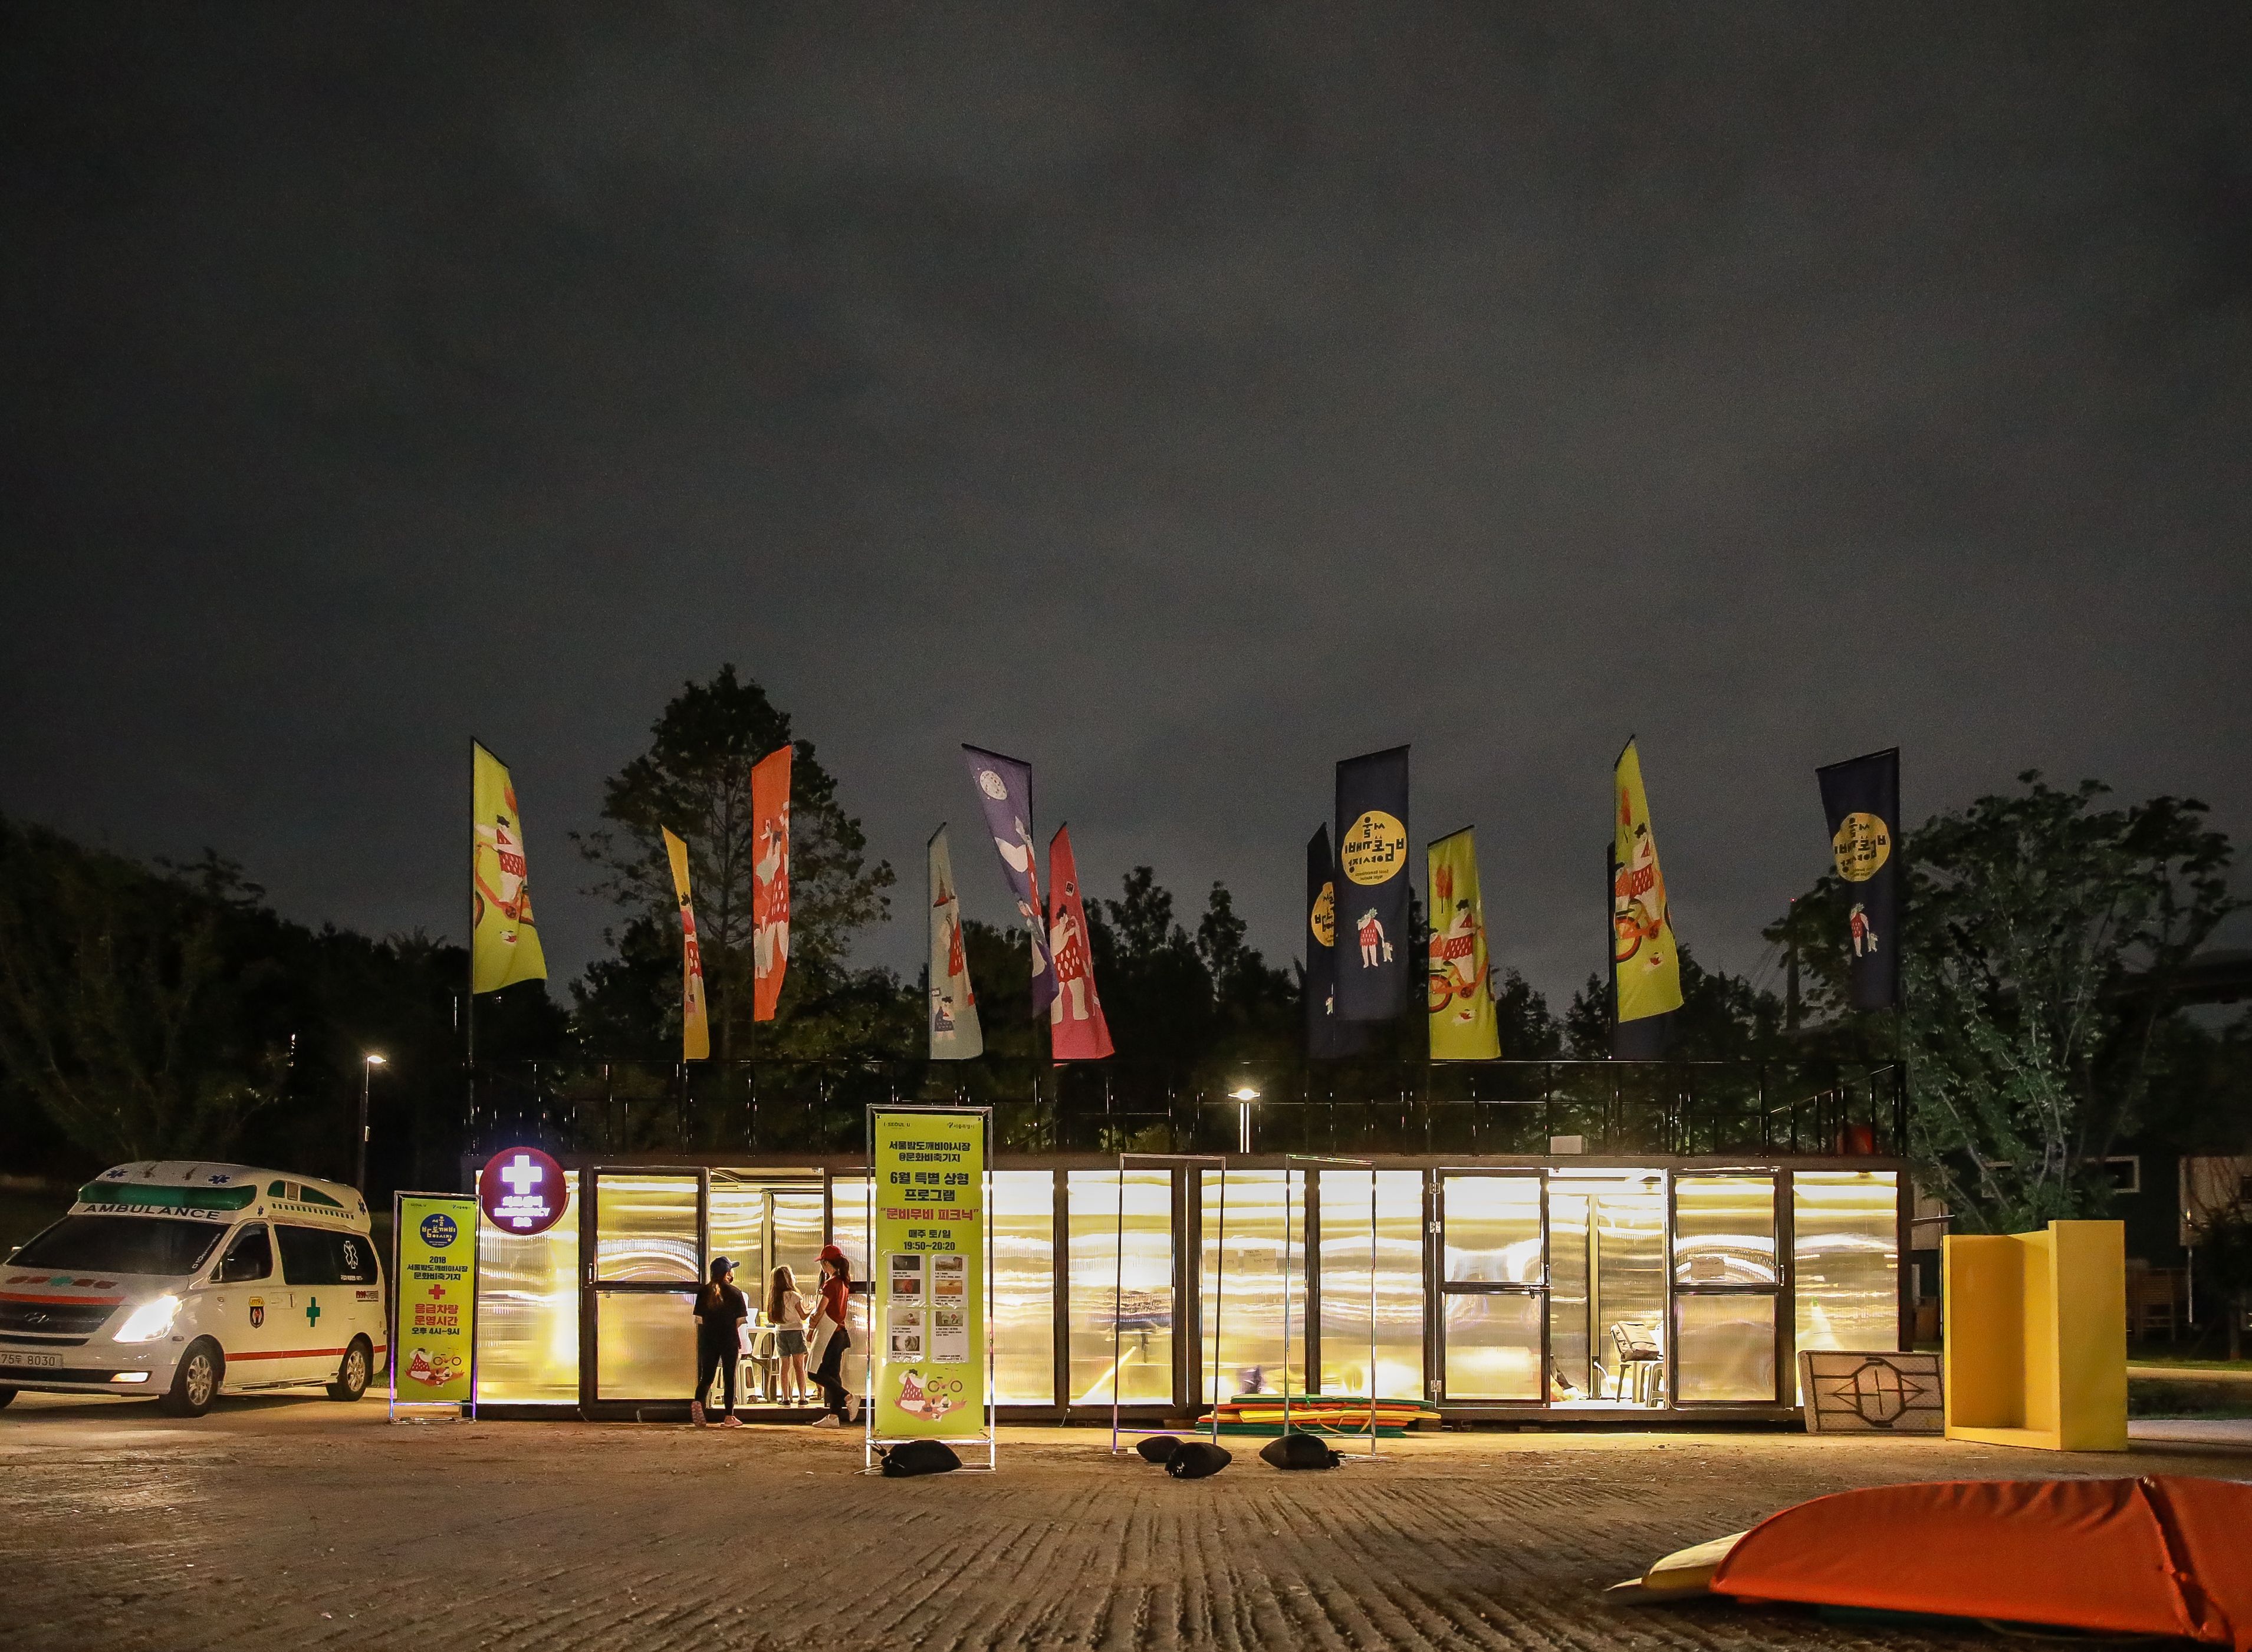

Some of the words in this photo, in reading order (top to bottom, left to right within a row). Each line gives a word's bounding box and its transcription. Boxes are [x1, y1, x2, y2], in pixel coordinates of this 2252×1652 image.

[889, 1141, 971, 1151] 서울밤도깨비야시장
[899, 1153, 961, 1162] @문화비축기지
[890, 1171, 911, 1184] 6월
[915, 1172, 940, 1184] 특별
[904, 1189, 955, 1202] 프로그램
[83, 1204, 221, 1220] AMBULANCE
[432, 1216, 445, 1226] 서울
[908, 1229, 926, 1238] 매주
[929, 1229, 951, 1239] 토/일
[903, 1242, 955, 1250] 19:50~20:20
[407, 1264, 468, 1272] 서울밤도깨비야시장
[415, 1304, 458, 1314] 응급차량
[415, 1315, 458, 1326] 운영시간
[27, 1355, 55, 1366] 8030
